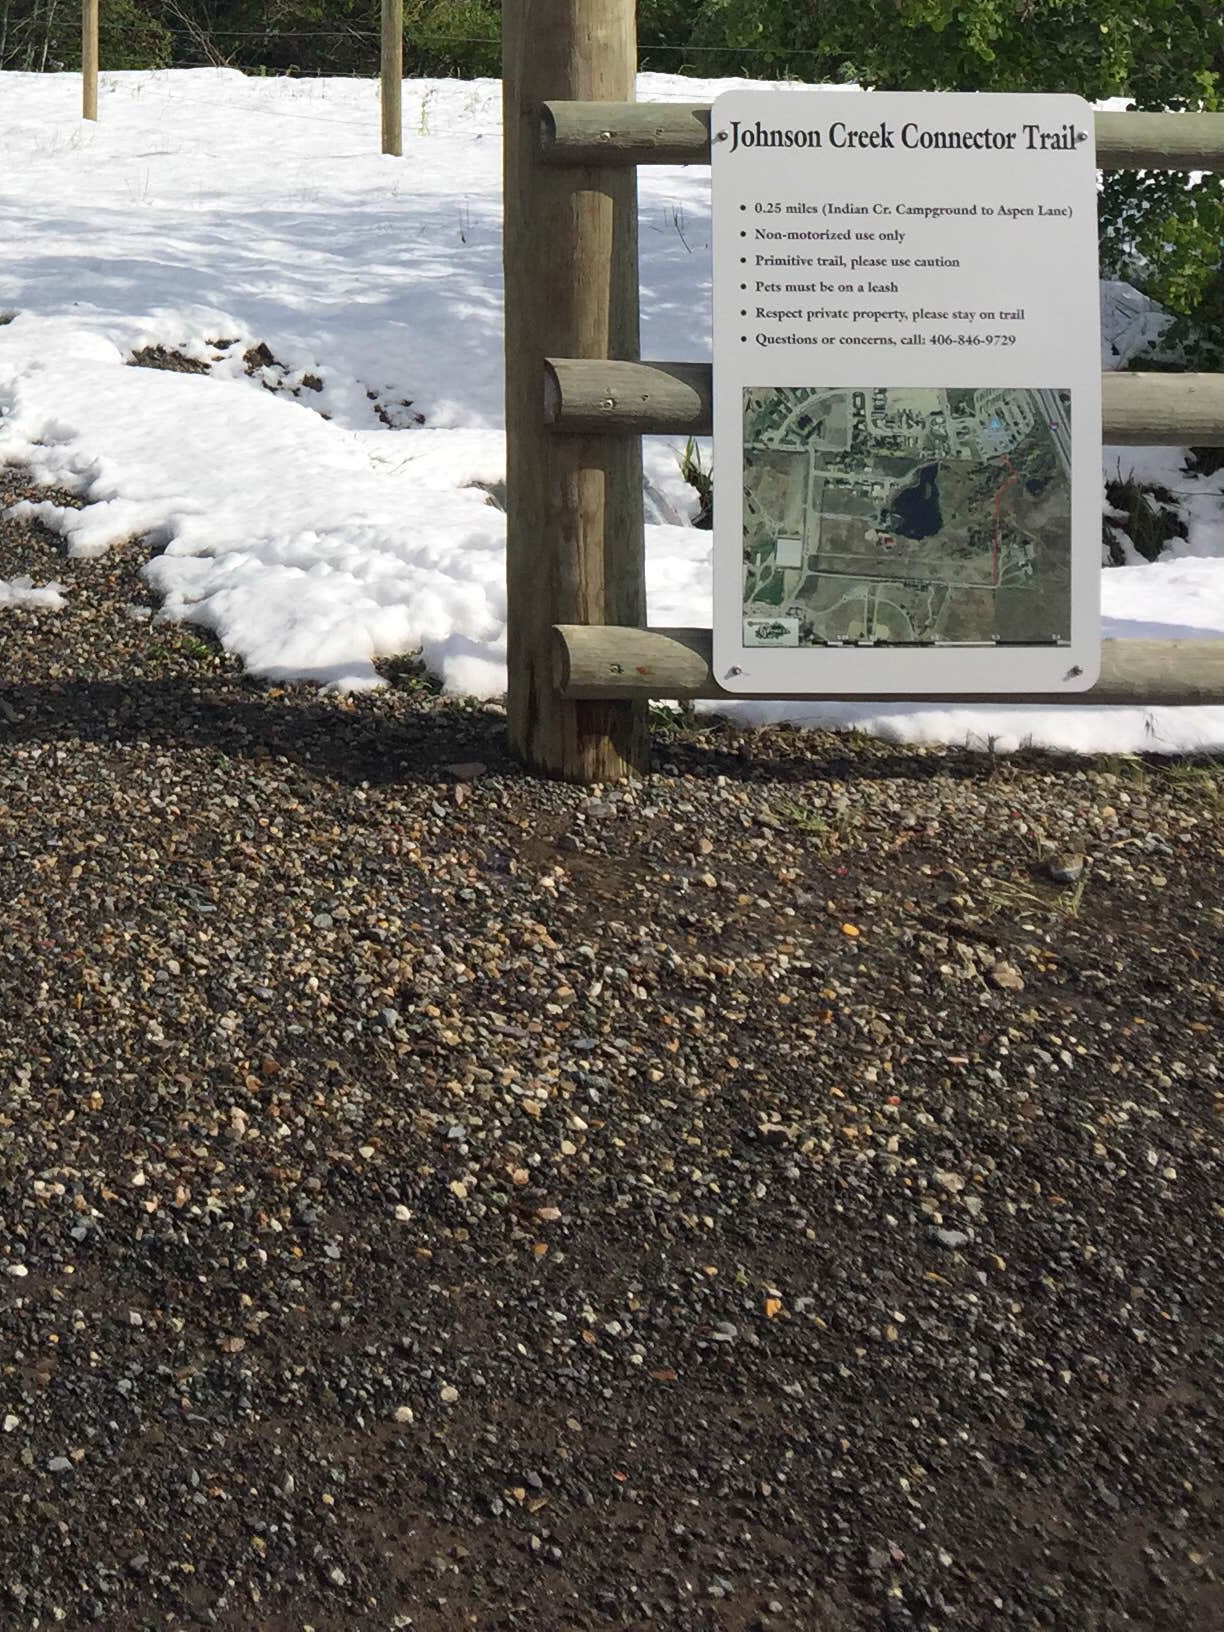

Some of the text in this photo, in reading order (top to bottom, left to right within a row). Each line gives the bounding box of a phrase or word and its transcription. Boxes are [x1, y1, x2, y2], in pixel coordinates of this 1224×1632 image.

[729, 121, 1077, 153] Johnson Creek Connector Trail
[754, 202, 1073, 219] 0.25 miles (Indian Cr. Campground to Aspen Lane)
[754, 228, 906, 244] Non-motorized use only
[755, 255, 960, 269] Primitive trail, please use caution
[755, 281, 899, 293] Pets must be on a leash
[755, 307, 1025, 323] Respect private property, please stay on trail
[755, 333, 1016, 347] Questions or concerns, call: 406-846-9729
